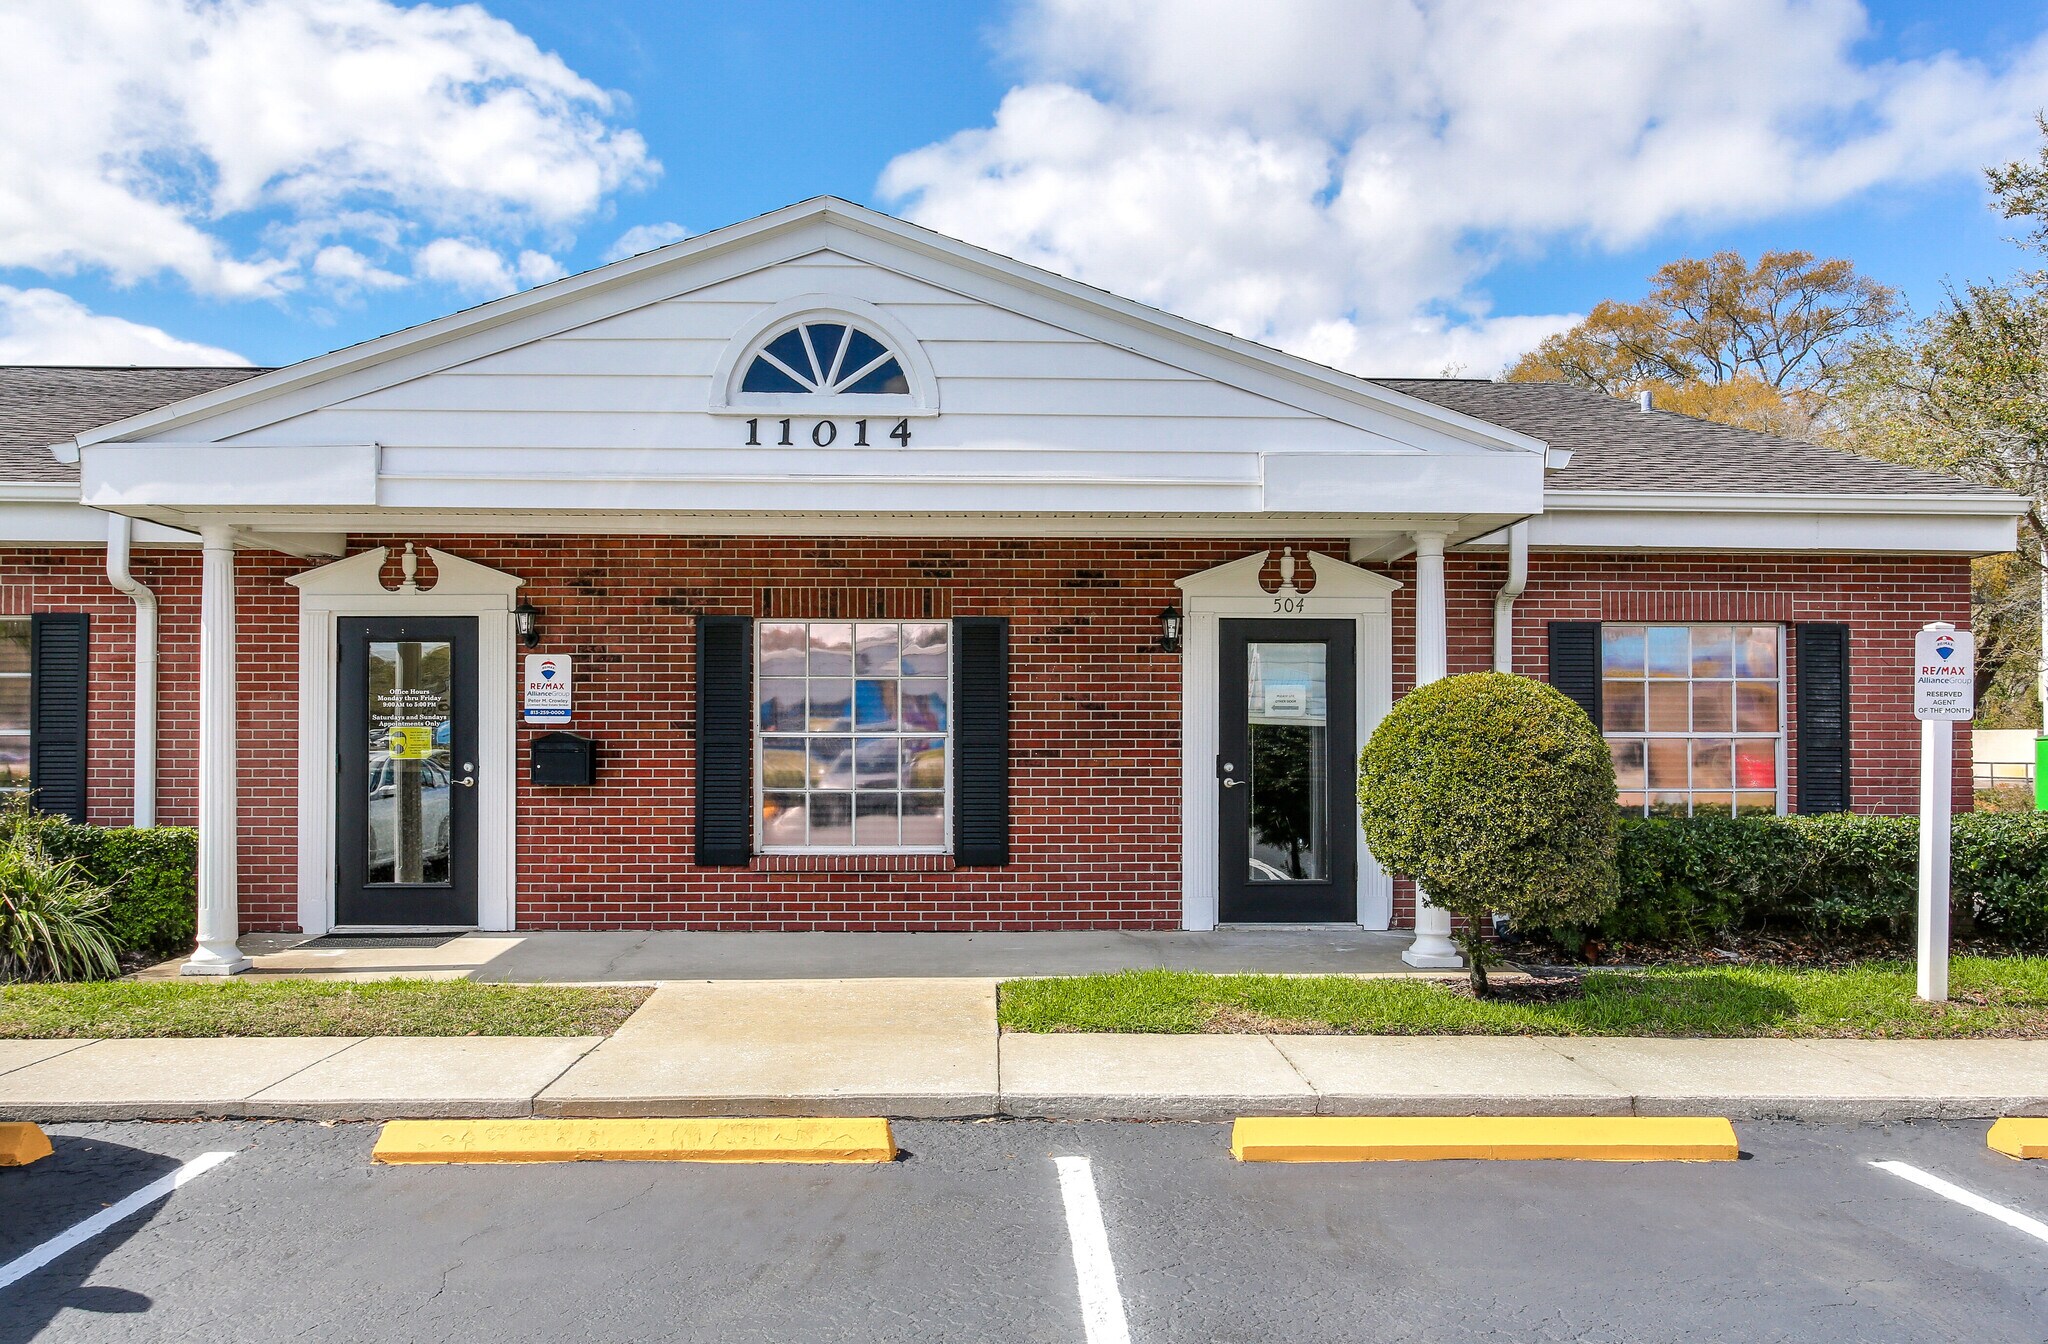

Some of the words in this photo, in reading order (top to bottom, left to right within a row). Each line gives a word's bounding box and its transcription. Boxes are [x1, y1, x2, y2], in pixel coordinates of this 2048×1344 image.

[745, 417, 912, 447] 11014
[1273, 598, 1304, 613] 504
[1922, 666, 1965, 675] RE/MAX
[1917, 677, 1972, 685] AllianceGroup
